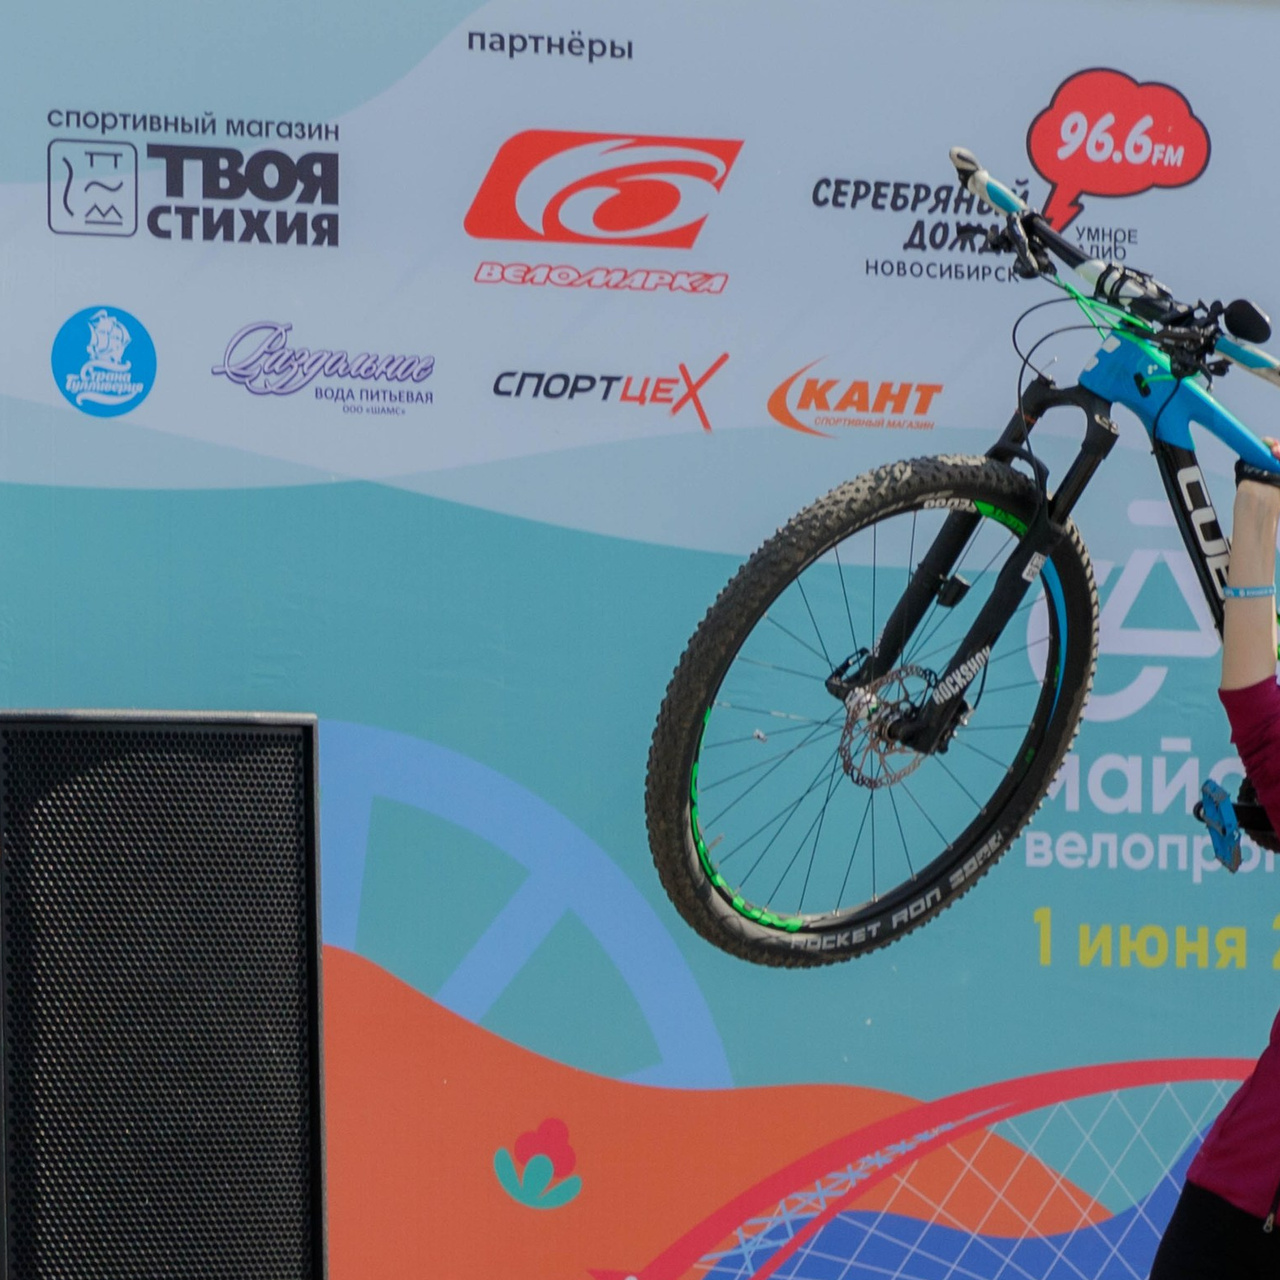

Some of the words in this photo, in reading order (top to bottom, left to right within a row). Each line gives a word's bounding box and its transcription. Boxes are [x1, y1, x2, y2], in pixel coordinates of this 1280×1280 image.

[468, 30, 633, 63] партнёры
[47, 109, 217, 135] спортивный
[226, 117, 339, 141] магазин
[147, 143, 339, 205] ТВОЯ
[147, 205, 339, 247] СТИХИЯ
[903, 220, 1004, 254] ДОЖД
[474, 261, 728, 294] ВЕЛОМАРКА
[865, 259, 1020, 283] НОВОСИБИРСК
[211, 320, 436, 396] Раздольное
[315, 386, 356, 403] ВОДА
[360, 389, 433, 405] ПИТЬЕВАЯ
[796, 377, 943, 415] КАНТ
[814, 416, 884, 429] СПОРТИВНЫЙ
[886, 419, 935, 431] МАГАЗИН
[1033, 907, 1051, 966] 1
[1078, 923, 1247, 970] июня
